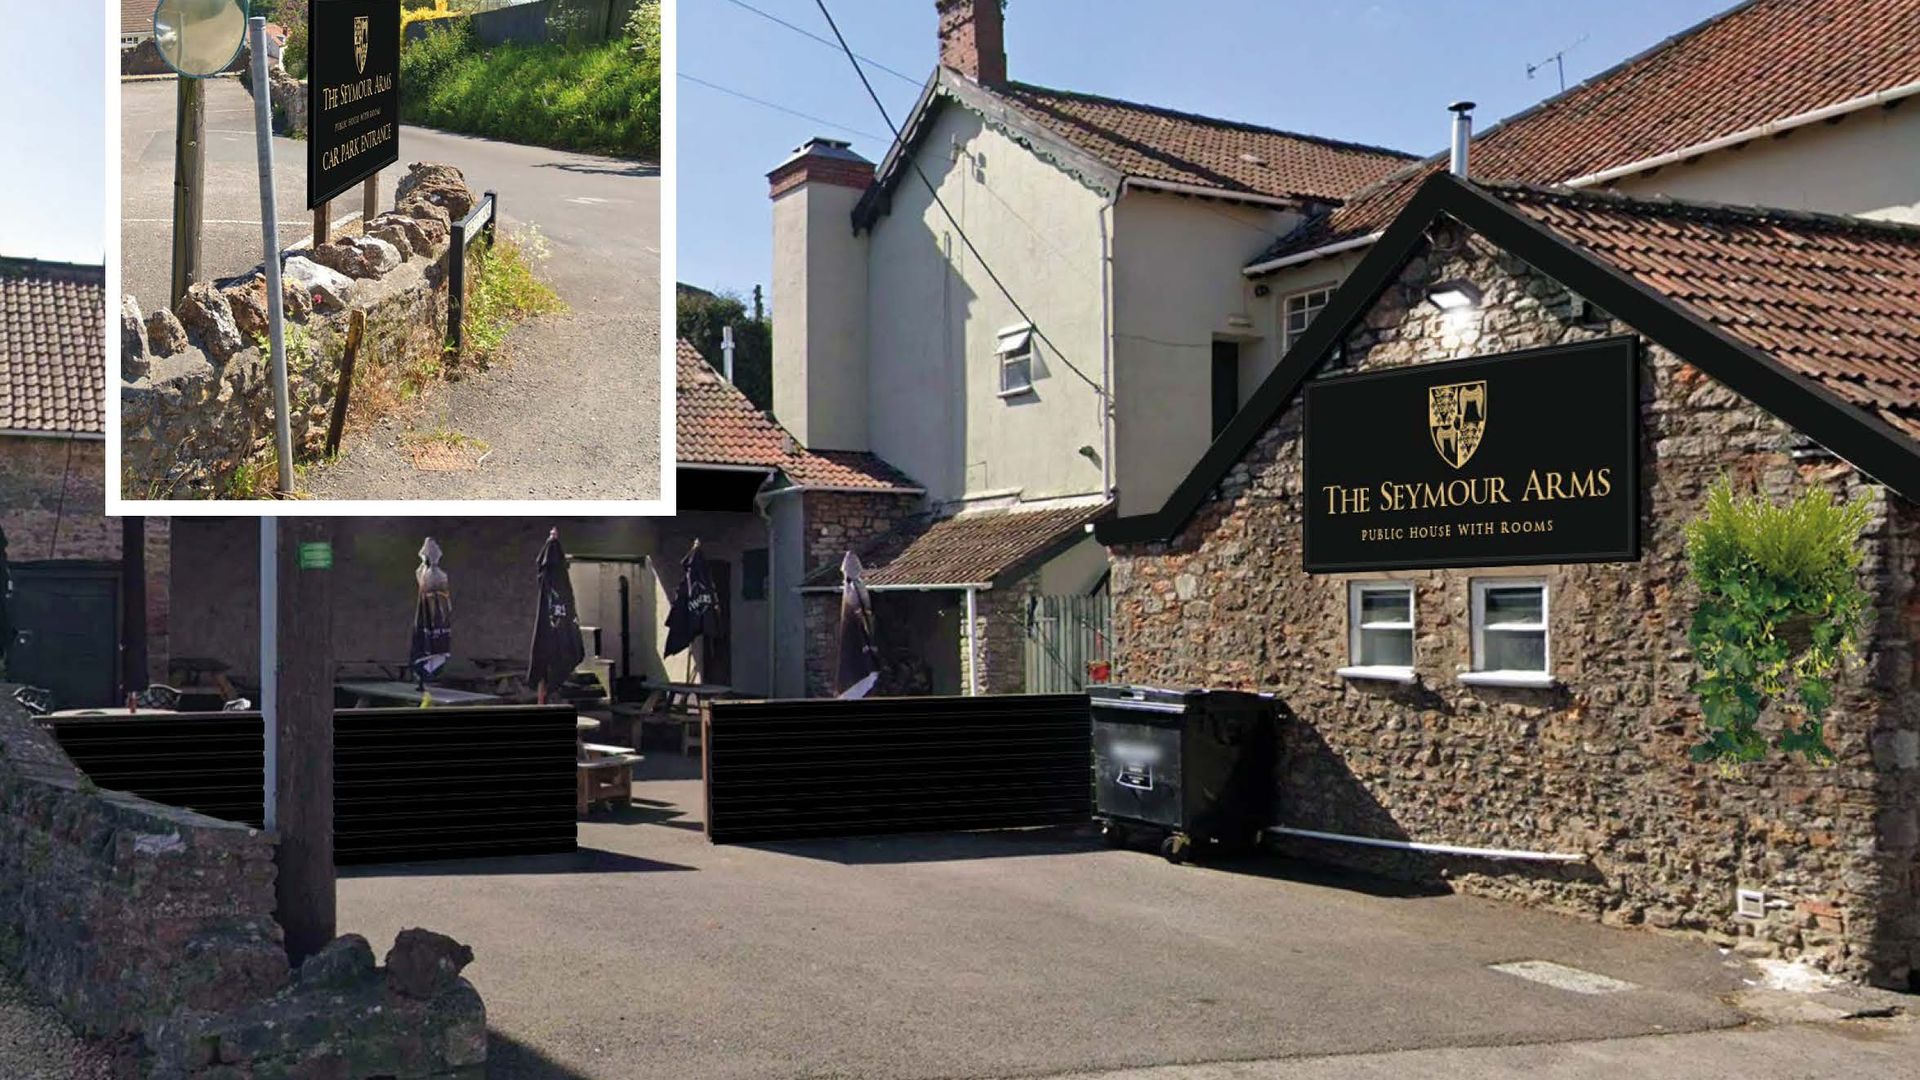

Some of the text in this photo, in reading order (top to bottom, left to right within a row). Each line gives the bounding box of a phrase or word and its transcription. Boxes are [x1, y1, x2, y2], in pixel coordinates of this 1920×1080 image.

[322, 72, 392, 111] THE SEYMOUR ARMS
[322, 122, 392, 171] CAR PARK ENTRANCE
[1322, 468, 1612, 515] THE SEYMOUR ARMS
[1361, 520, 1553, 541] PUBLIC HOUSE WITH ROOMS
